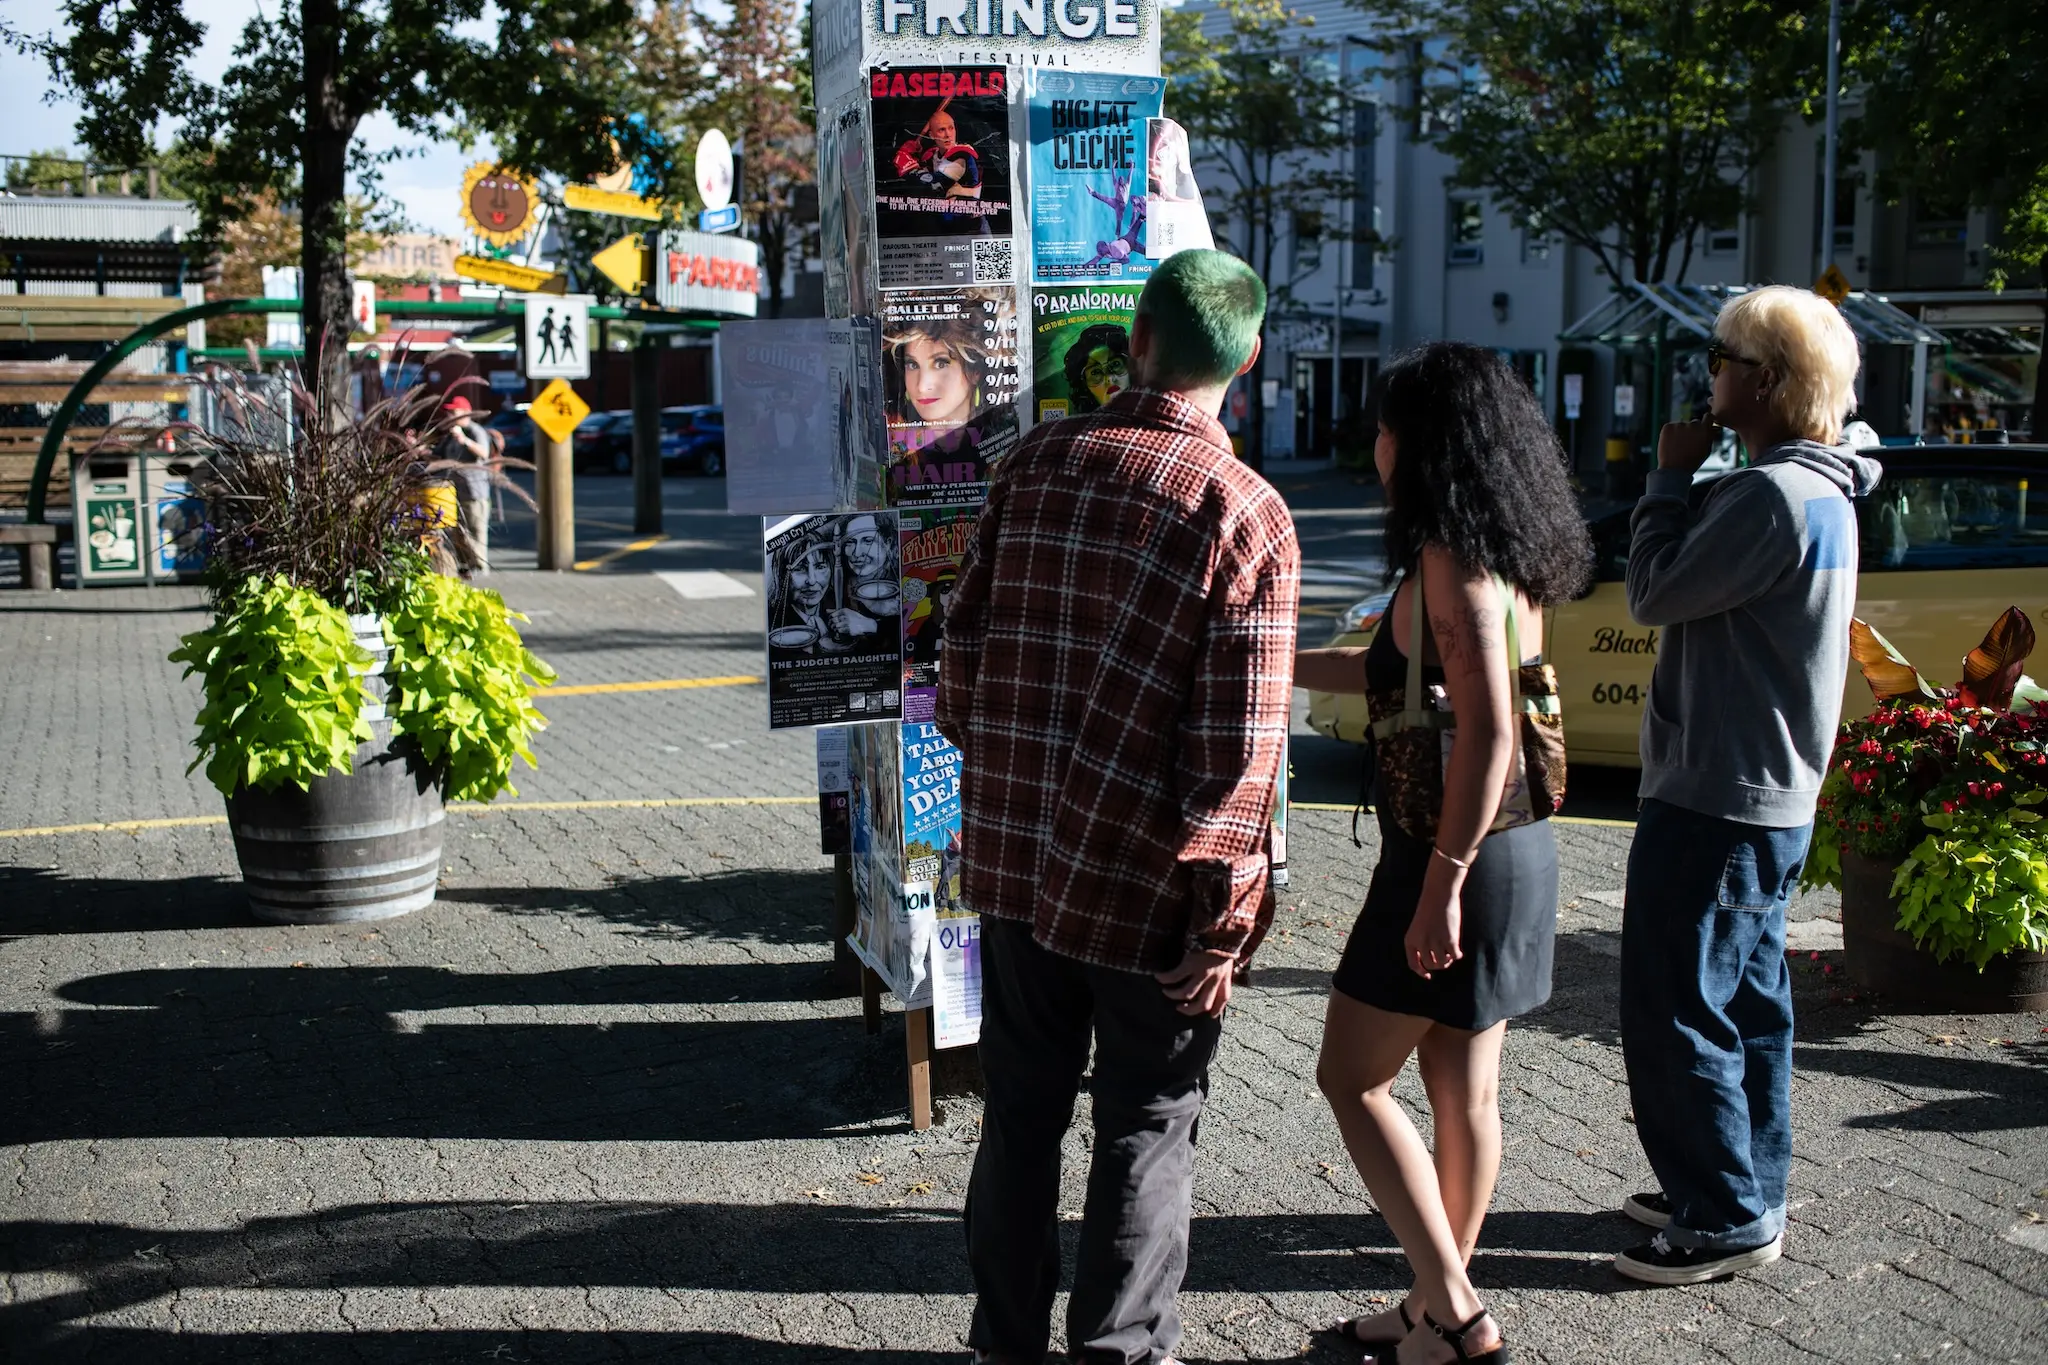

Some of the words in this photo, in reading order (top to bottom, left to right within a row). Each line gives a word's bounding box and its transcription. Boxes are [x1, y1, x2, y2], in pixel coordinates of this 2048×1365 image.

[883, 0, 1138, 38] FRINGE
[816, 3, 859, 68] FRINGE
[959, 53, 1069, 66] FESTIVAL
[872, 71, 1005, 97] BASEBALD
[1052, 100, 1089, 128] BIG
[1093, 100, 1137, 127] FAT
[876, 195, 888, 203] ONE
[980, 201, 992, 209] ONE
[889, 202, 897, 210] TO
[898, 203, 908, 211] HIT
[922, 204, 949, 213] FASTEST
[1128, 265, 1152, 273] FRINGE
[943, 303, 962, 313] BC
[1034, 288, 1143, 316] PARANORMA
[905, 313, 958, 322] CARTWRIGHT
[985, 373, 1018, 388] 9/16
[893, 462, 976, 485] HAIR
[896, 498, 933, 507] DIRECTED
[765, 533, 791, 552] Laugh
[790, 525, 805, 539] Cry
[804, 515, 828, 532] Judge
[902, 525, 948, 566] FAKE
[1589, 627, 1659, 654] Black
[772, 661, 792, 670] THE
[795, 657, 839, 668] JUDGE'S
[842, 653, 899, 665] DAUGHTER
[1592, 682, 1648, 705] 604-
[919, 725, 942, 738] LE
[920, 750, 964, 772] ABOU
[907, 765, 957, 790] YOUR
[908, 777, 961, 817] DEA
[946, 809, 961, 820] FRING
[910, 863, 938, 875] SOLD
[912, 870, 938, 883] OUT!
